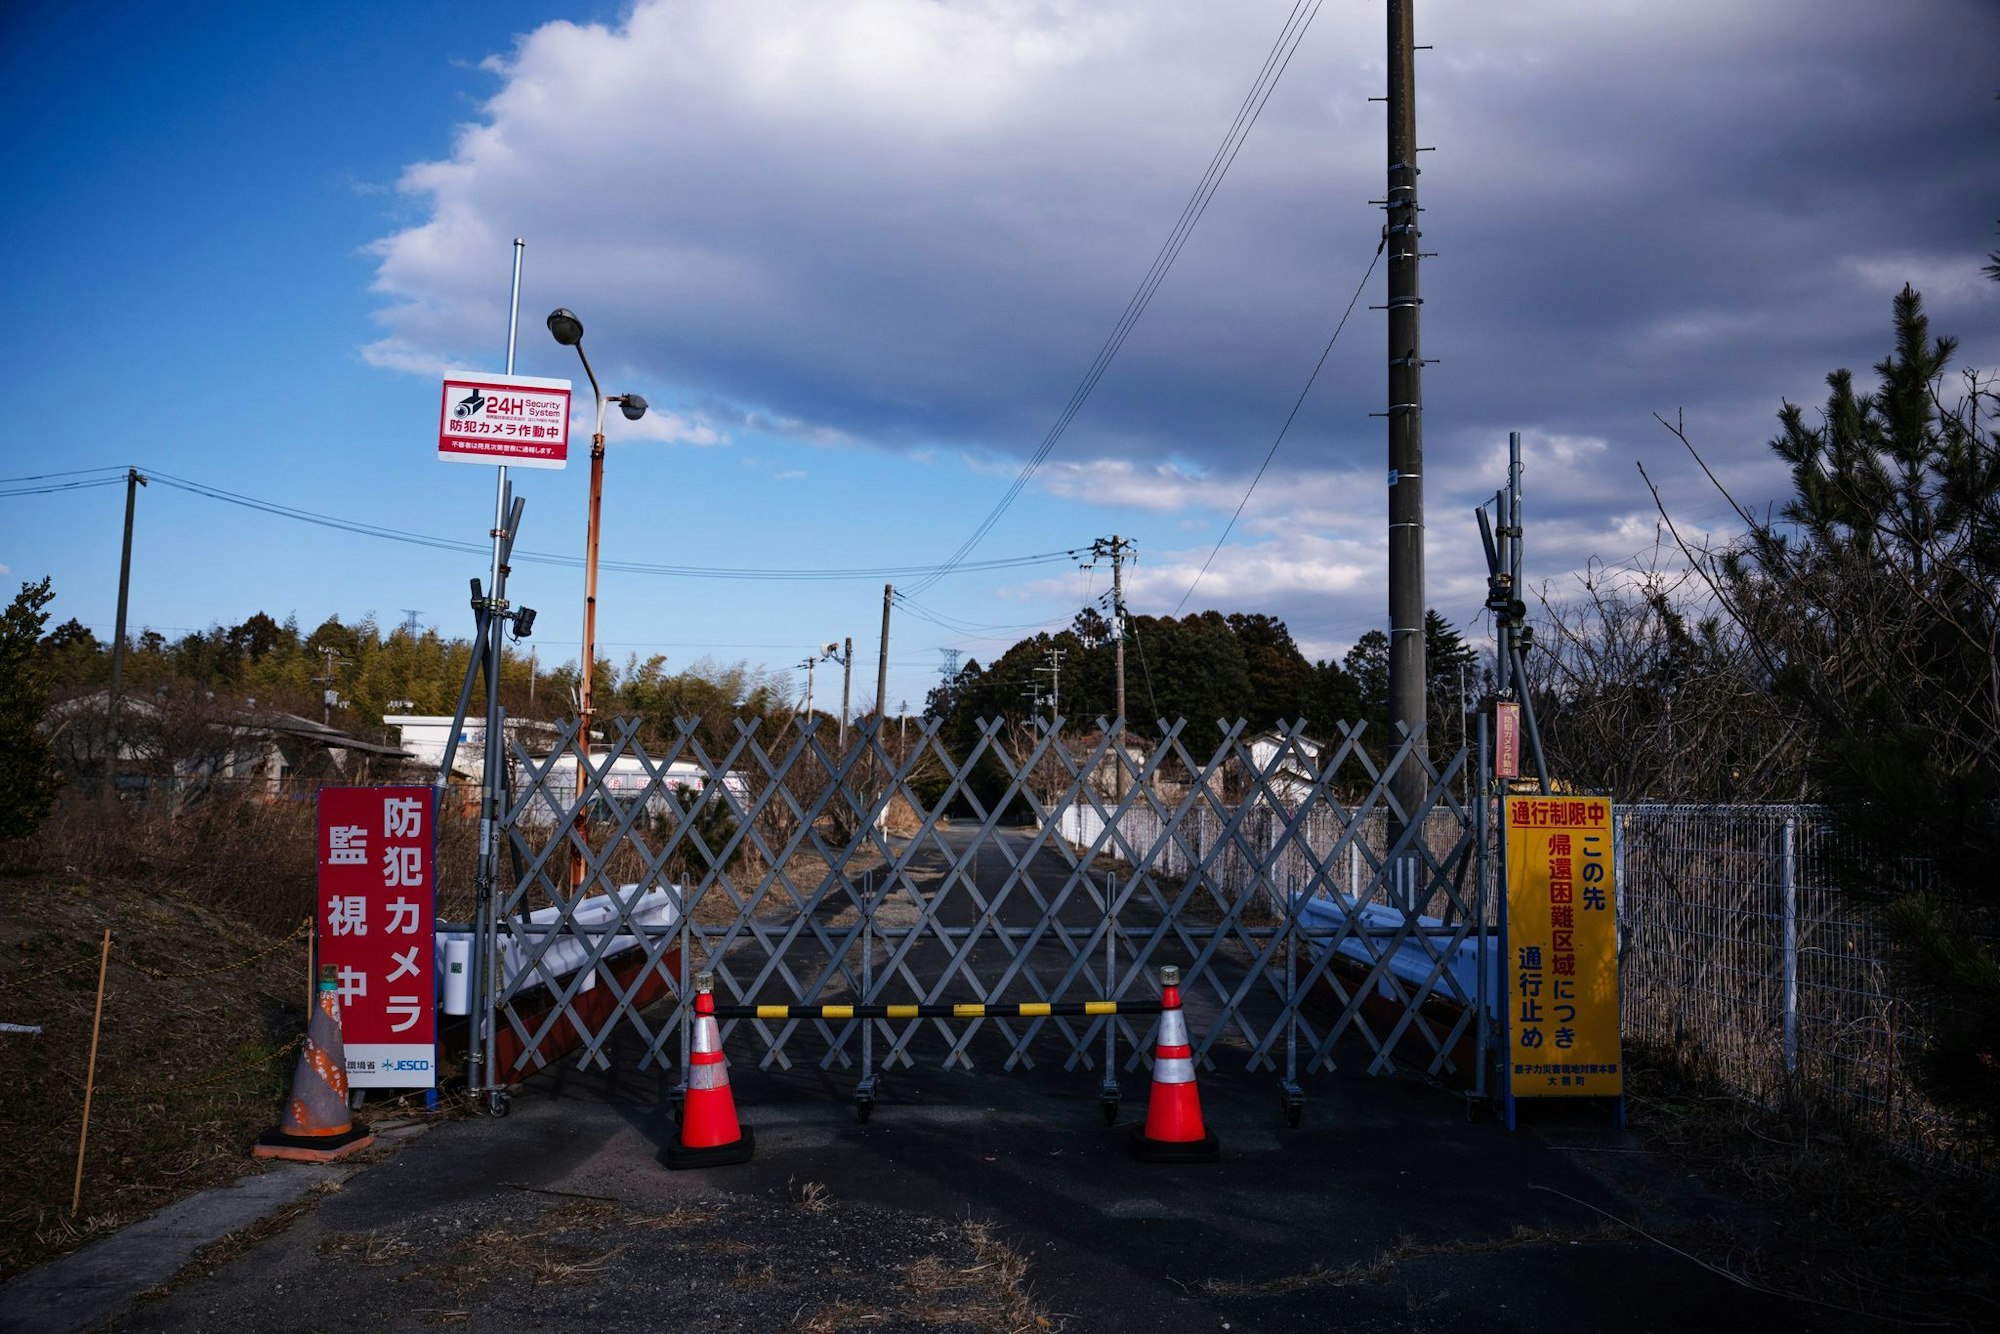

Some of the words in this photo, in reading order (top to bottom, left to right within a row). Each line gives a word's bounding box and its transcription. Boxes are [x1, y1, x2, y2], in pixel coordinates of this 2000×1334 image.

[486, 396, 524, 415] 24H
[525, 399, 560, 410] Security
[529, 407, 560, 417] System
[449, 419, 559, 438] 防犯カメラ作動中
[1512, 801, 1604, 826] 通行制限中
[1582, 836, 1605, 911] この先
[328, 825, 368, 1007] 監視中
[383, 797, 423, 1033] 防犯カメラ
[1519, 946, 1543, 1049] 通行止め
[394, 1060, 429, 1071] JESCO
